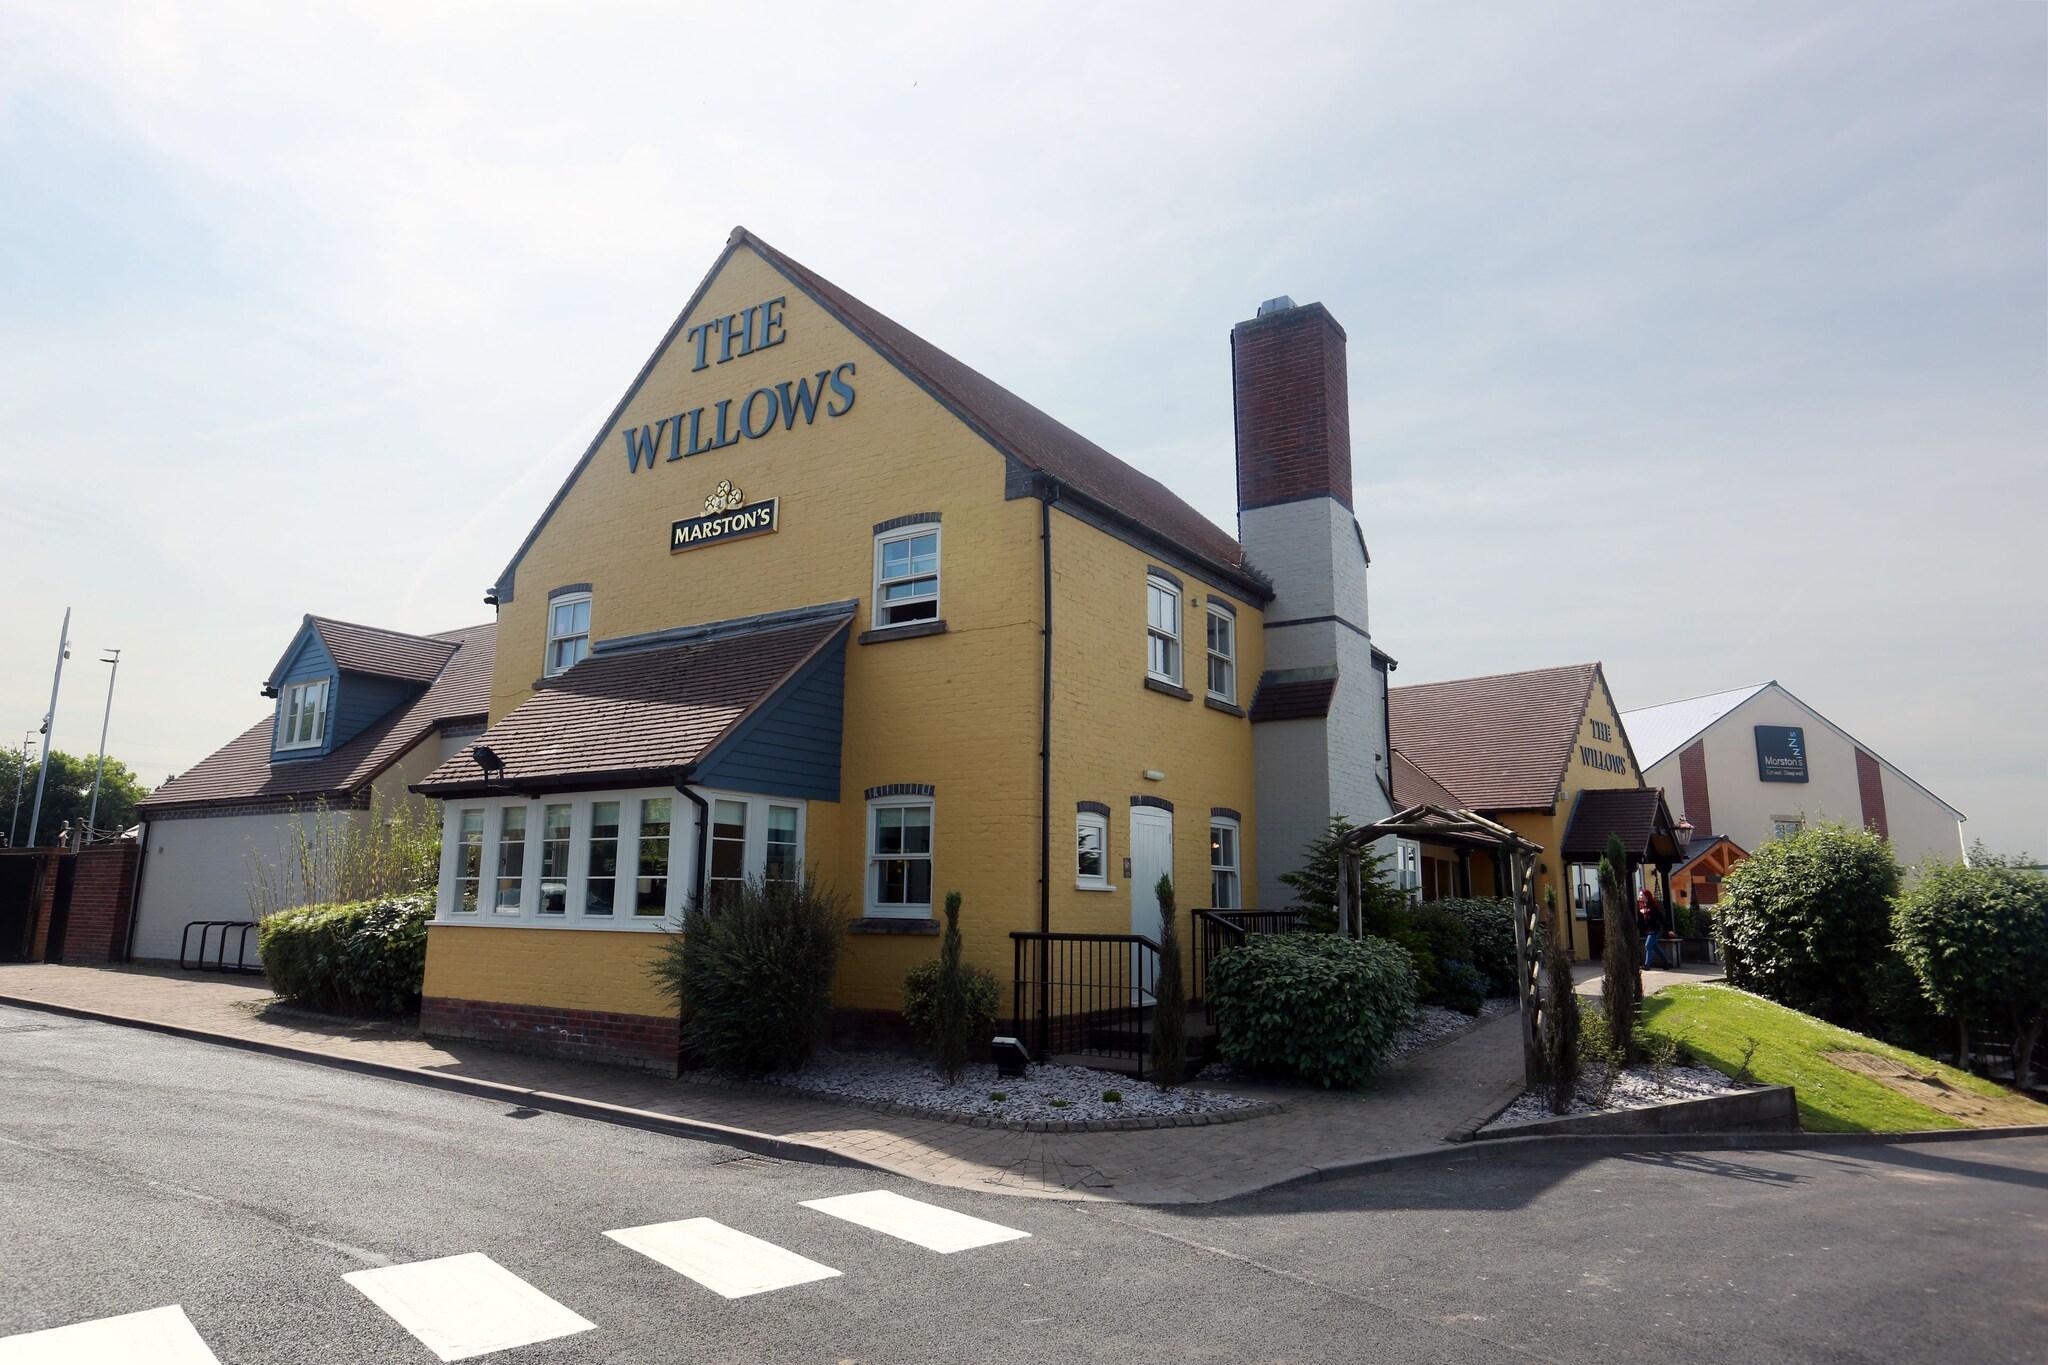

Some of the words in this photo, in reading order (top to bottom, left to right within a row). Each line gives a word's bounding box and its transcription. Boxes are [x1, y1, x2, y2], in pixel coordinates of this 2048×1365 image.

[688, 296, 786, 372] THE
[623, 363, 856, 474] WILLOWS
[674, 508, 771, 545] MARSTON'S
[1589, 718, 1612, 743] THE
[1579, 745, 1626, 775] WILLOWS
